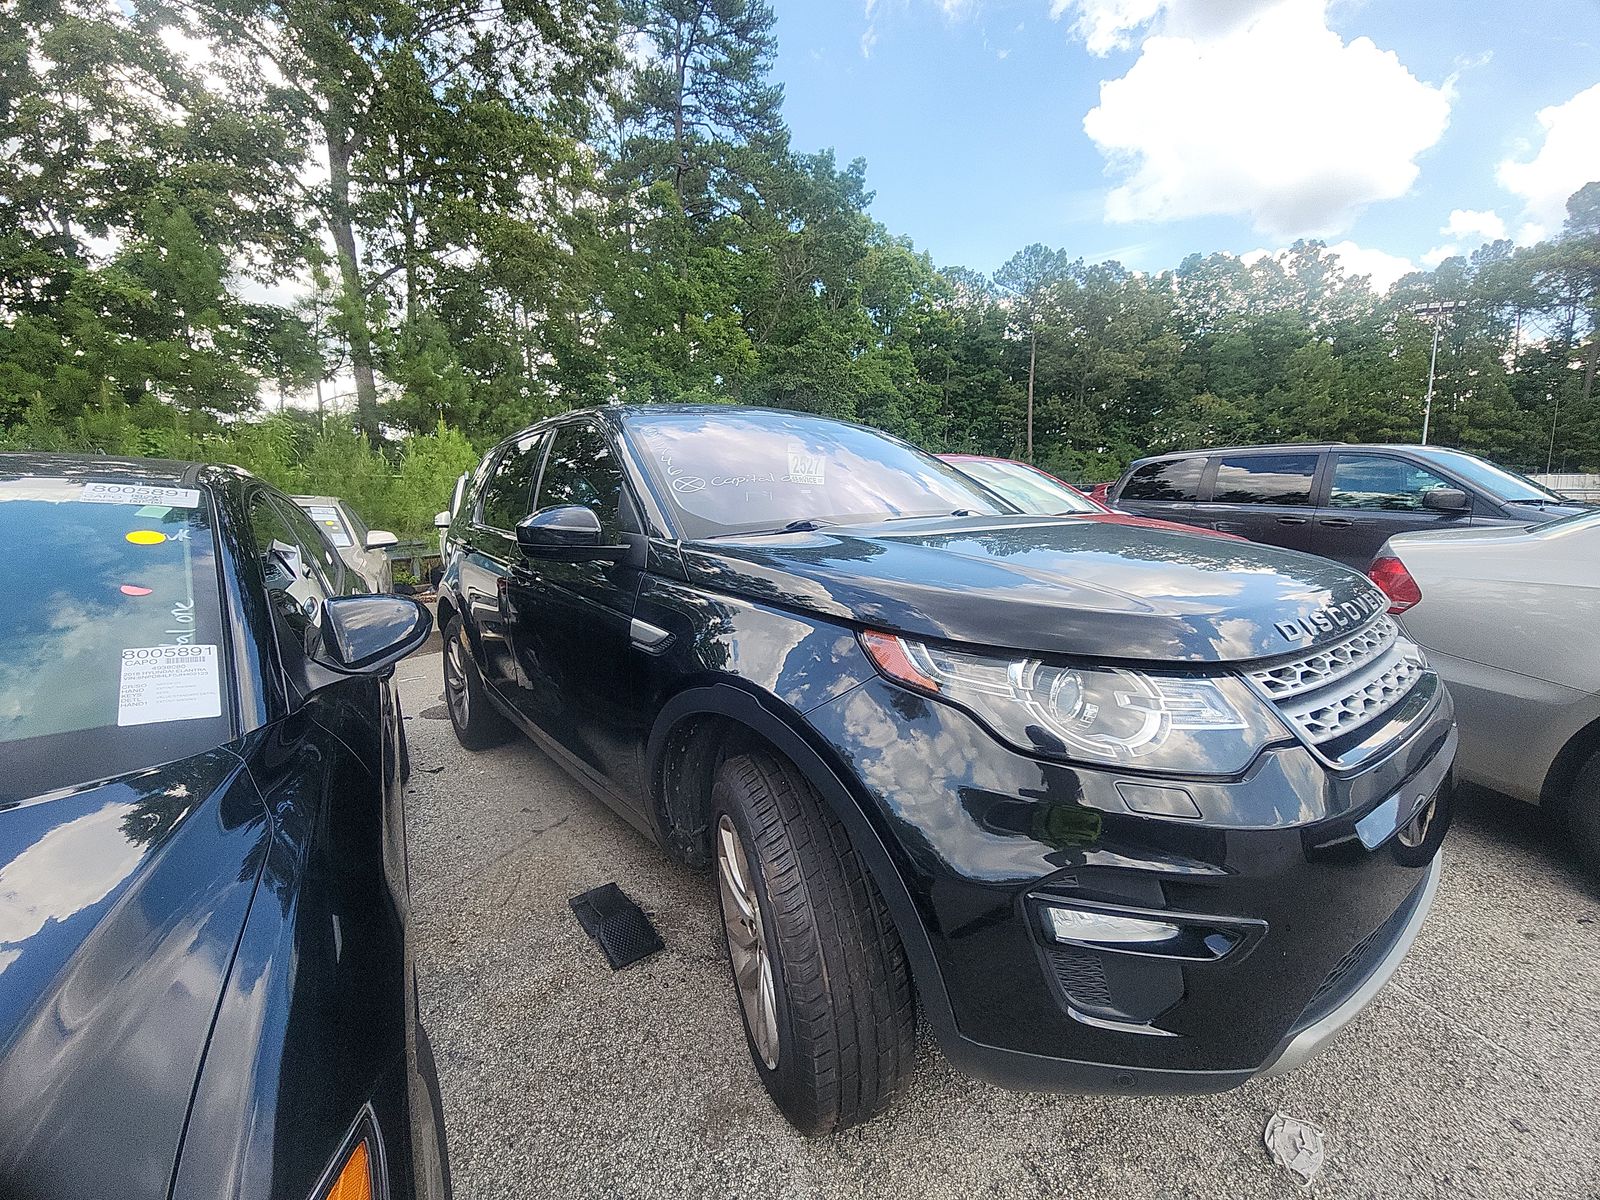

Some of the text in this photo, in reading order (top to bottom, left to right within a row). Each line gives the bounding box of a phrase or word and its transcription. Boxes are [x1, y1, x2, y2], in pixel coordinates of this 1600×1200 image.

[792, 455, 822, 475] 2527
[92, 485, 190, 498] 8005891
[122, 646, 212, 660] 8005891
